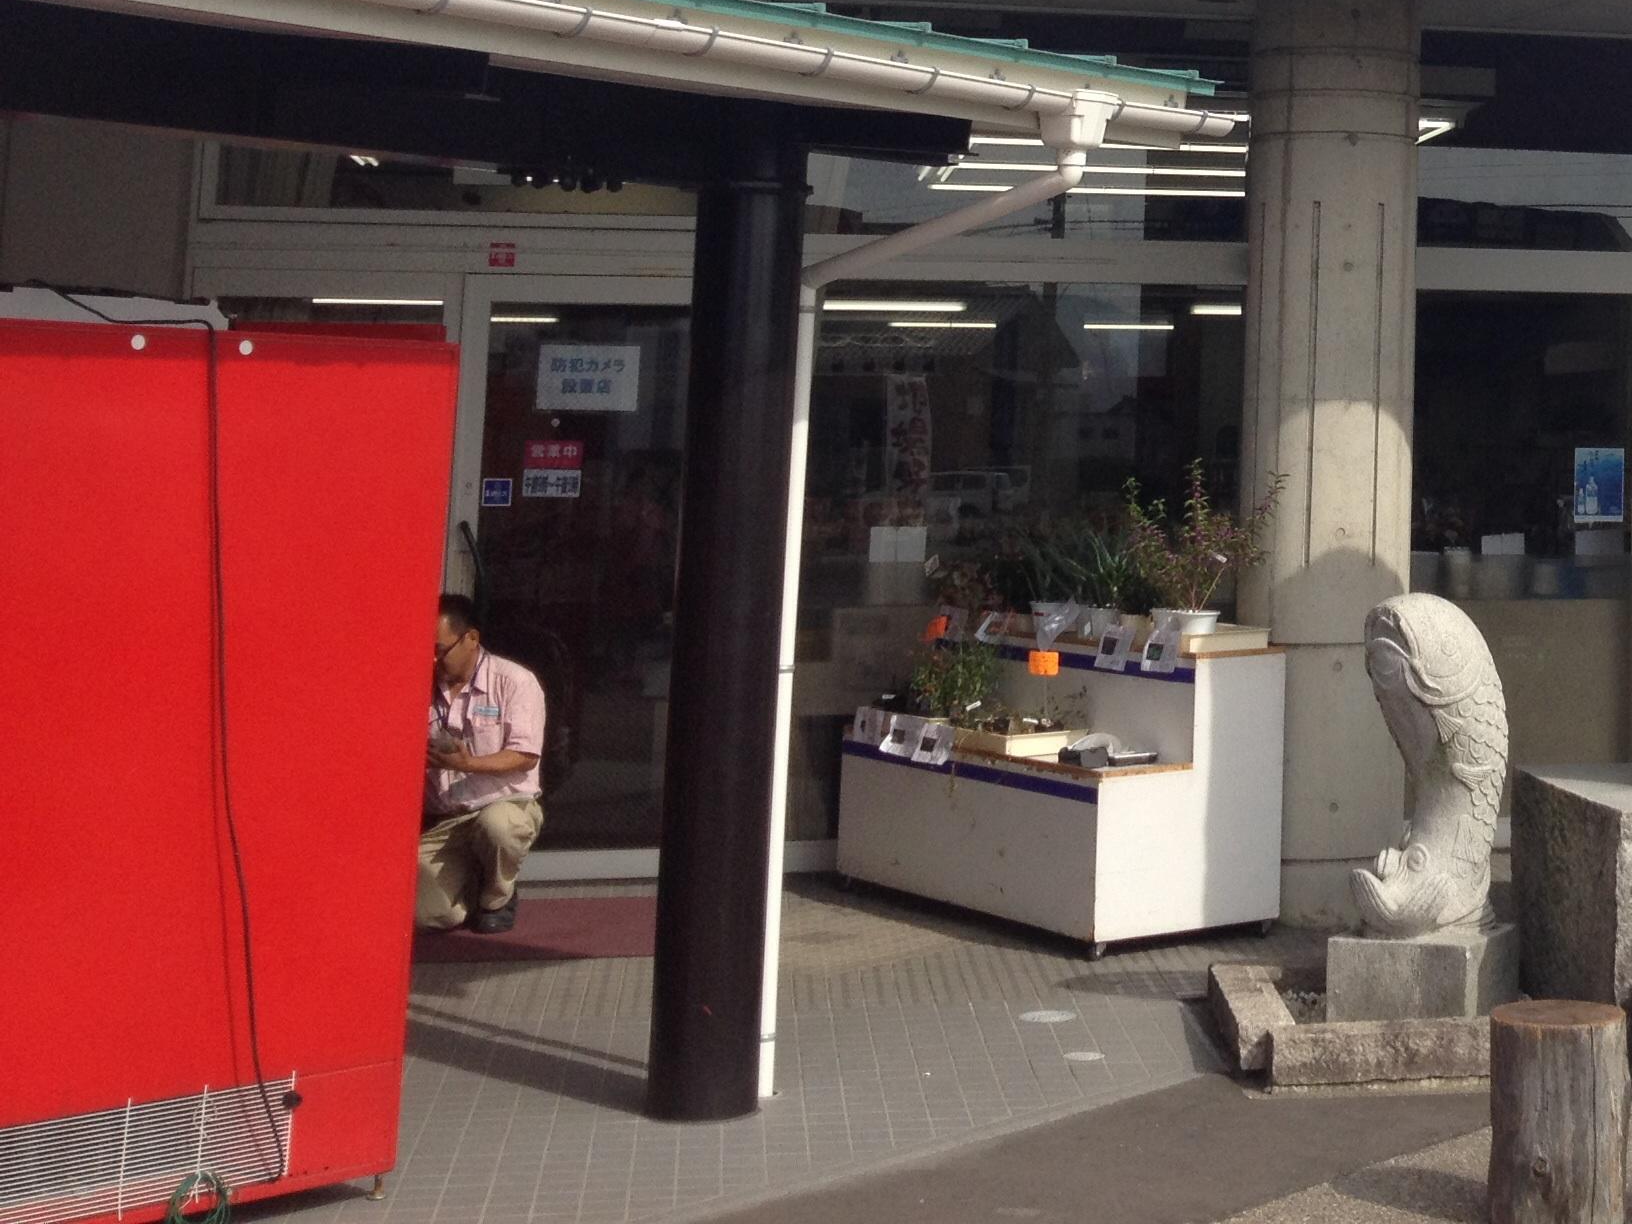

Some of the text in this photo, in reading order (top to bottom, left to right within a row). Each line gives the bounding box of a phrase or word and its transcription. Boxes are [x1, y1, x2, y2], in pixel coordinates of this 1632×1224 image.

[551, 357, 626, 373] 防犯カメラ
[560, 378, 612, 394] 設置店
[530, 443, 578, 458] 営業中
